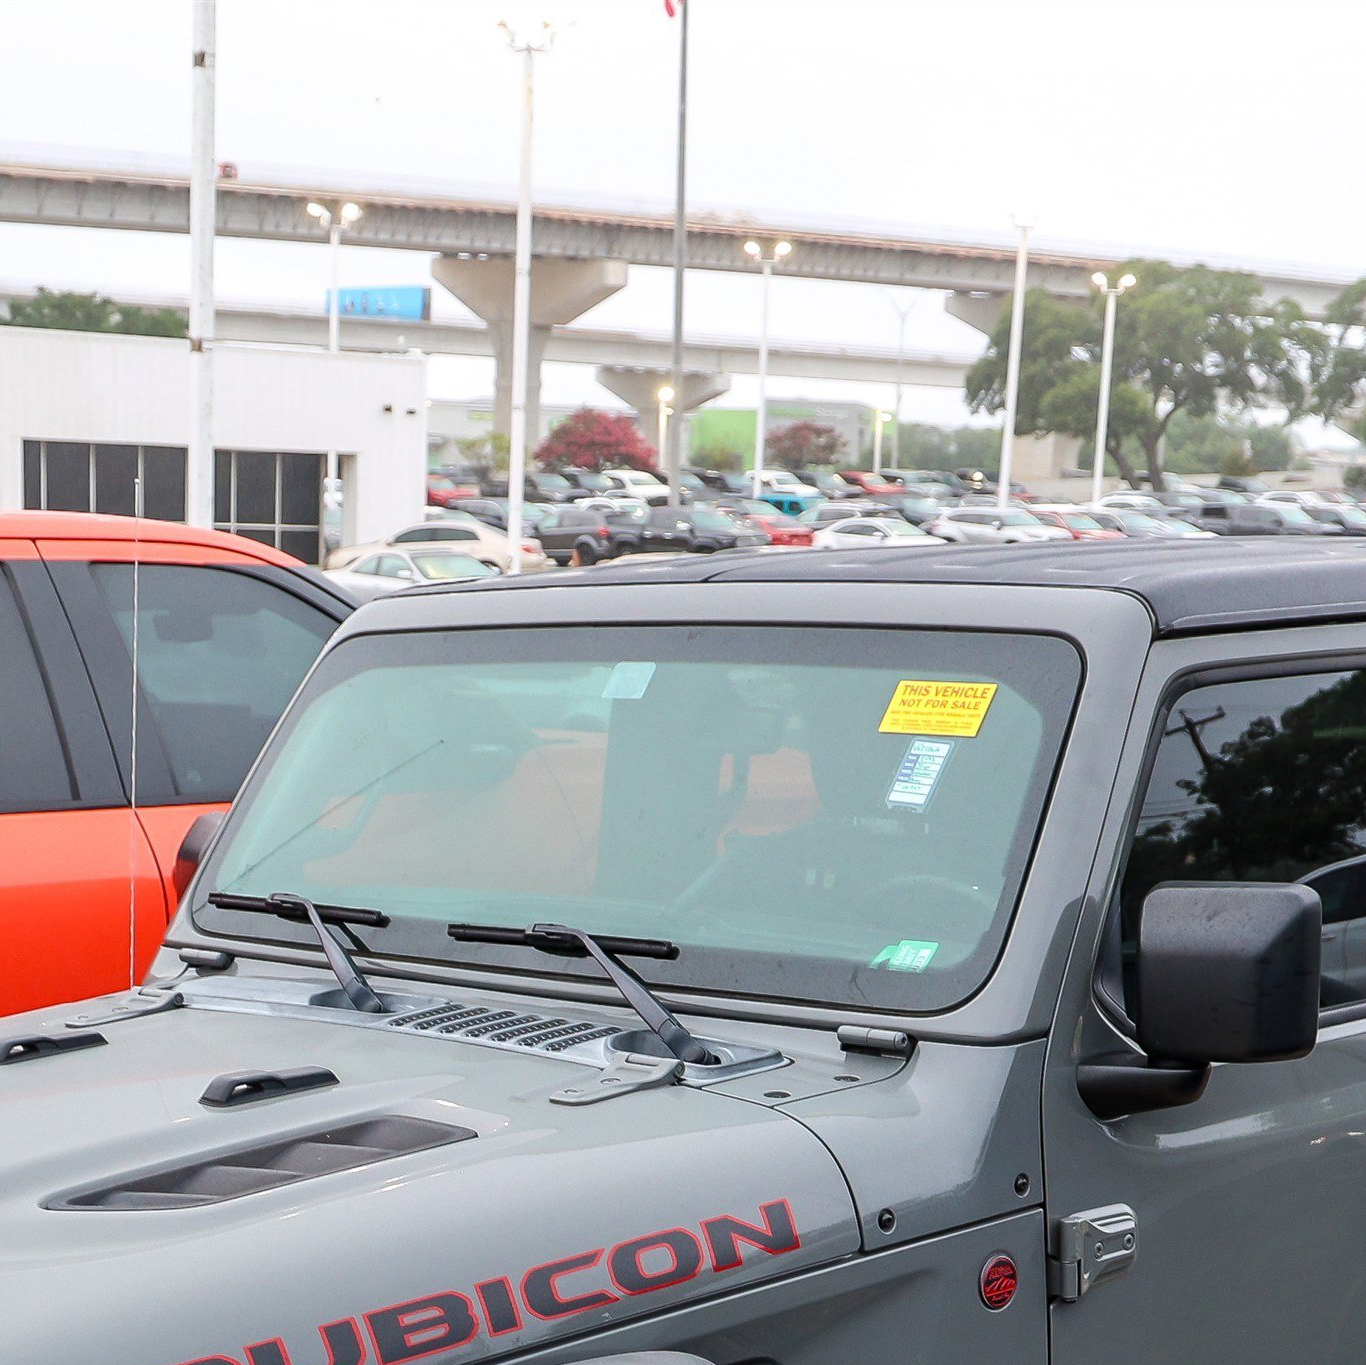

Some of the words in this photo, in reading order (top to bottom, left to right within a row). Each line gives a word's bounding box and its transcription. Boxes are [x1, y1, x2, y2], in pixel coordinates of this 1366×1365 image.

[902, 684, 932, 697] THIS
[934, 685, 991, 699] VEHICLE
[899, 698, 923, 708] NOT
[924, 699, 949, 709] FOR
[950, 700, 982, 710] SALE
